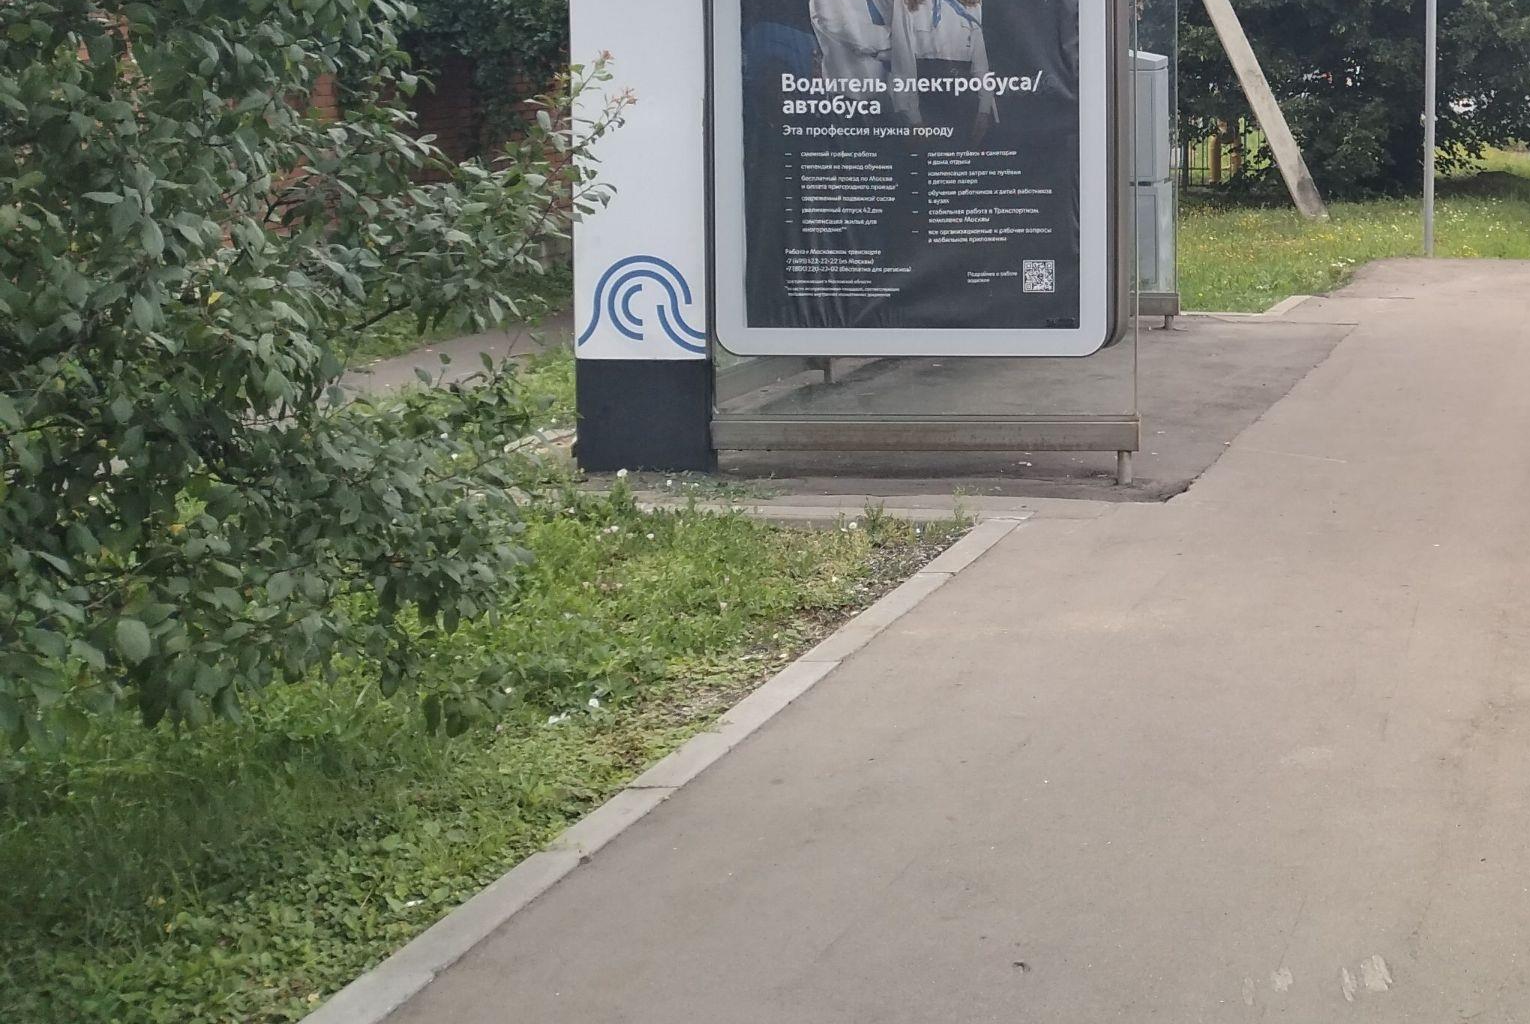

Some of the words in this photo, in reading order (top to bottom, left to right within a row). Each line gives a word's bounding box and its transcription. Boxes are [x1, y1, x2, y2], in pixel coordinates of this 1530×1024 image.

[781, 72, 887, 95] Водитель
[893, 70, 1043, 96] электробуса/
[782, 95, 882, 119] автобуса
[782, 125, 804, 136] Эта
[806, 125, 870, 139] профессия
[873, 127, 910, 136] нужна
[912, 126, 954, 138] городу
